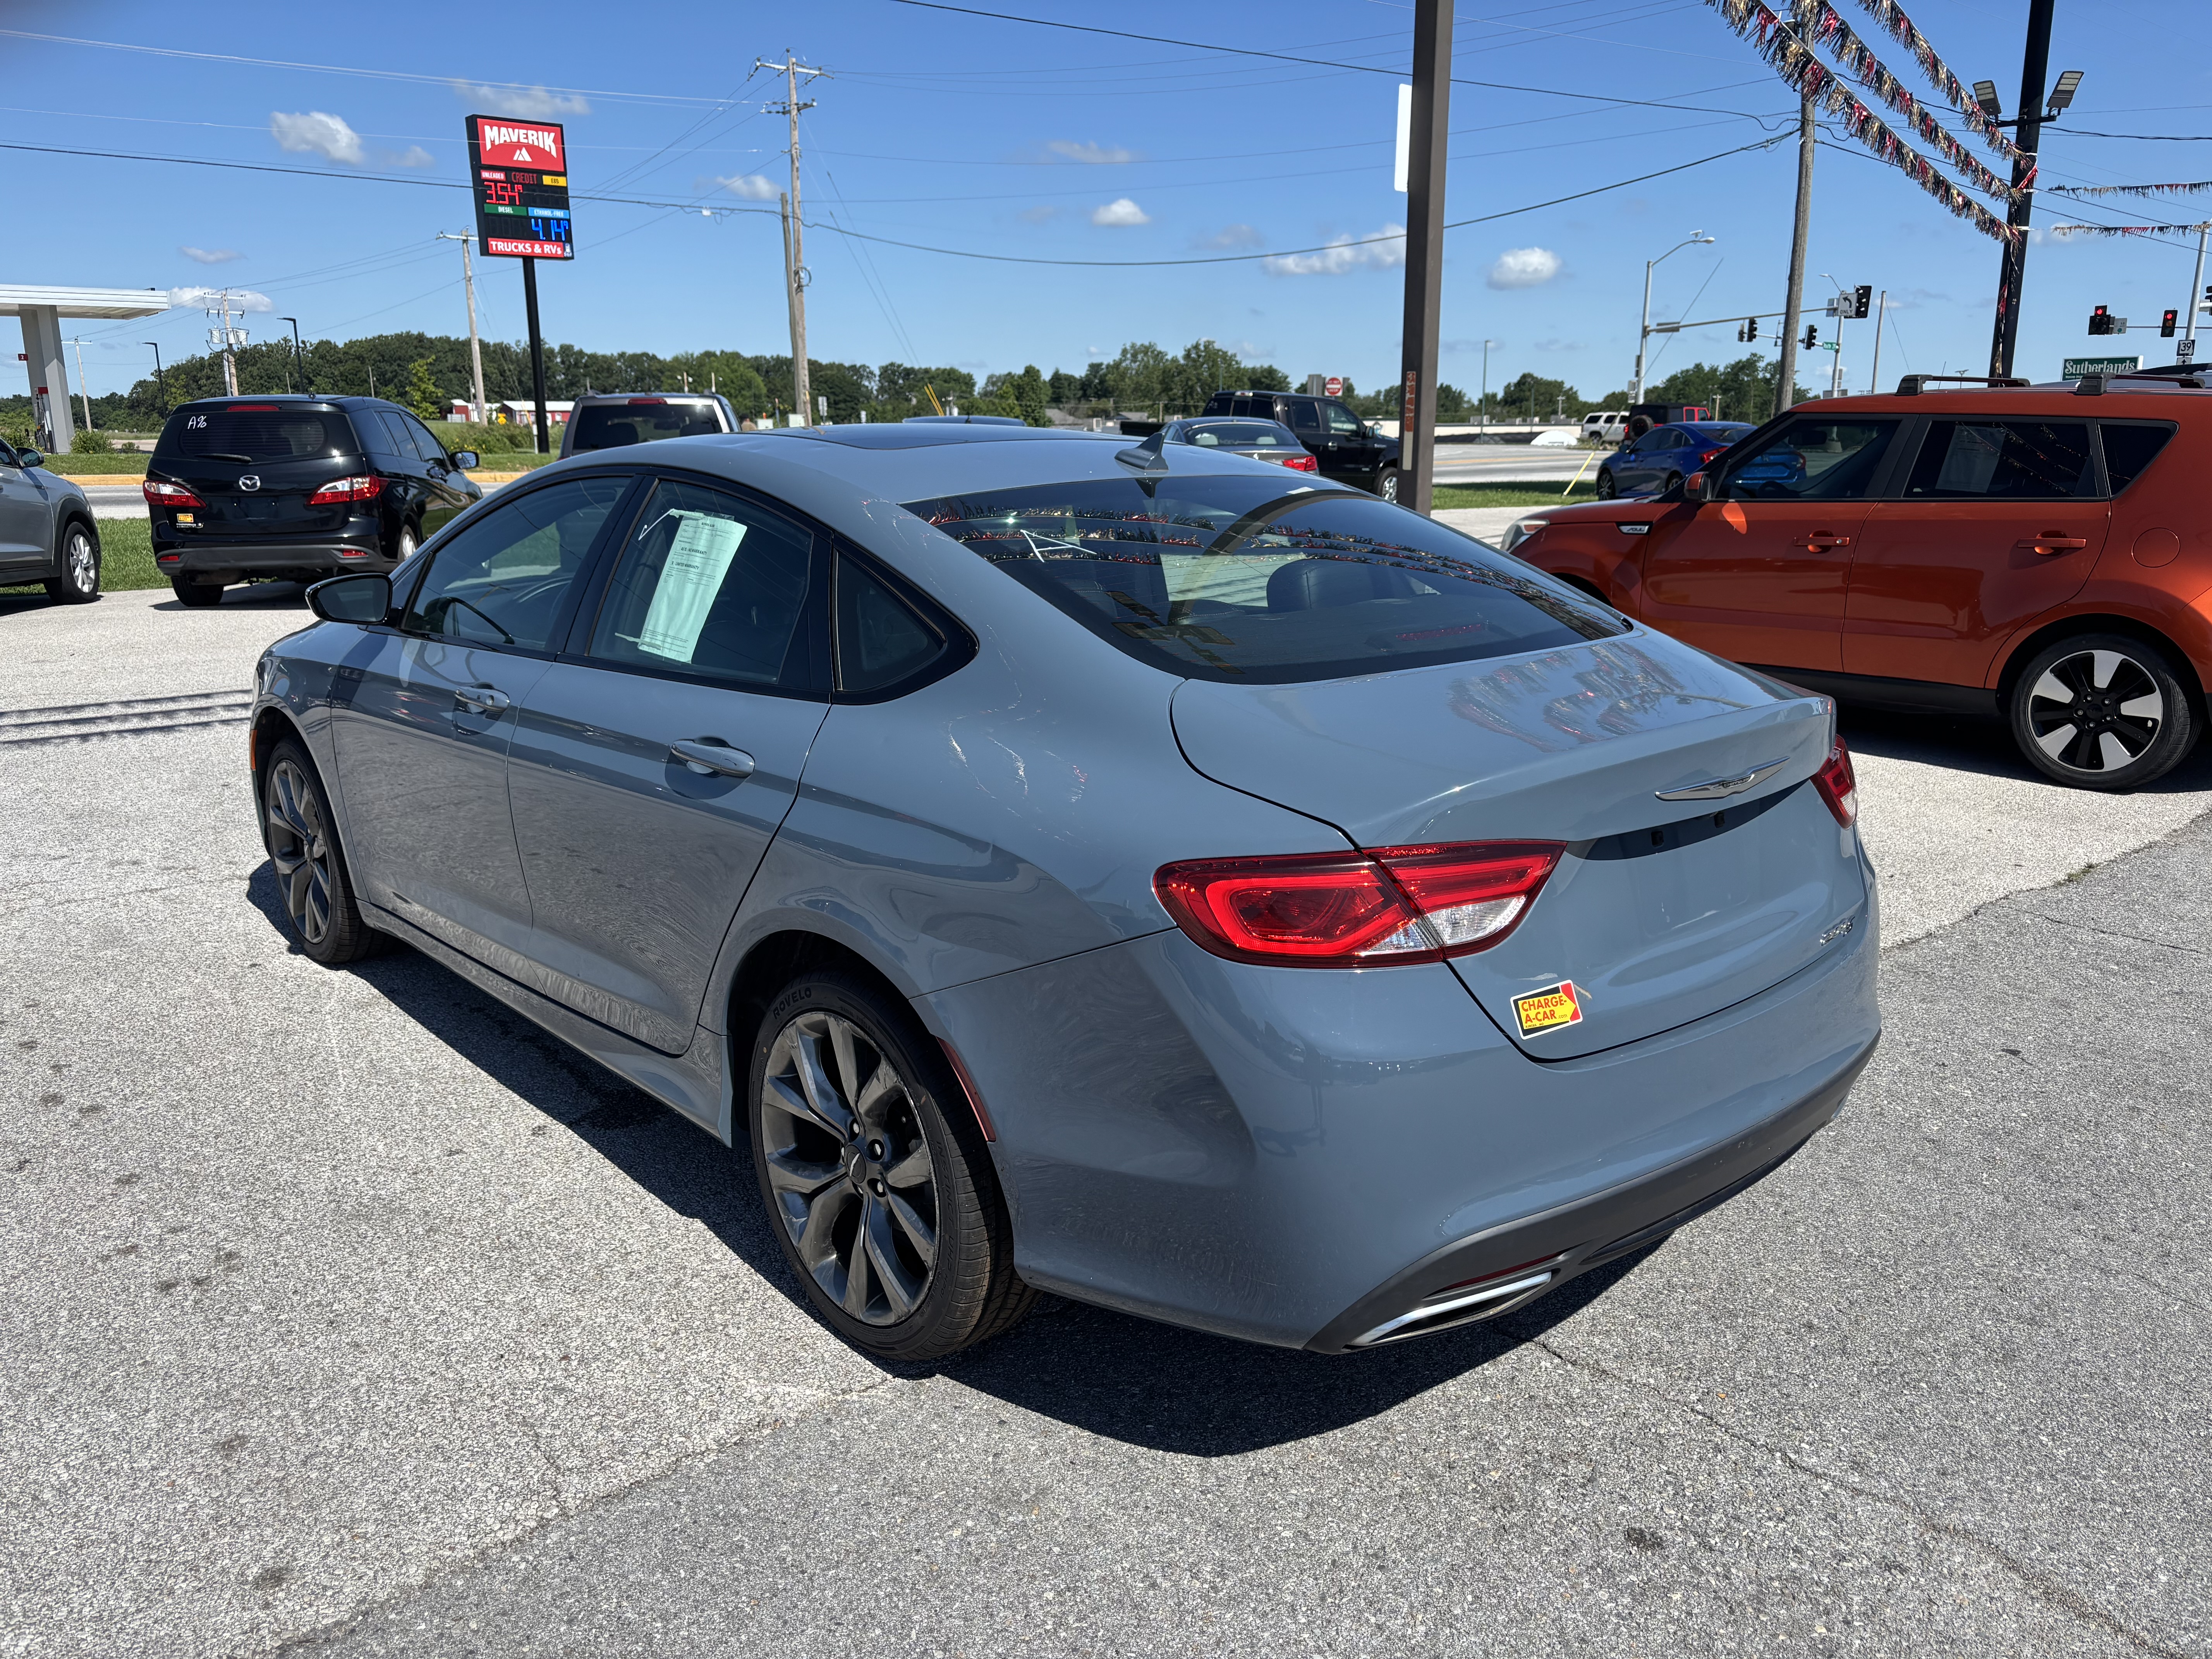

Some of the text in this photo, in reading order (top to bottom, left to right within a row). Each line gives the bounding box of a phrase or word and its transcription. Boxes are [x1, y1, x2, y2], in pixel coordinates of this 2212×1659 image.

[484, 125, 557, 158] MAVERIK
[512, 172, 537, 184] CREDIT
[498, 206, 514, 214] DIESEL
[490, 241, 562, 255] TRUCKS & RVs
[2181, 342, 2191, 351] 39
[2065, 360, 2135, 374] Sutherlands
[773, 987, 811, 1019] ROVELO
[1521, 995, 1567, 1012] CHARGE-
[1525, 1009, 1557, 1024] A-CAR
[936, 1141, 955, 1228] INSTINCT
